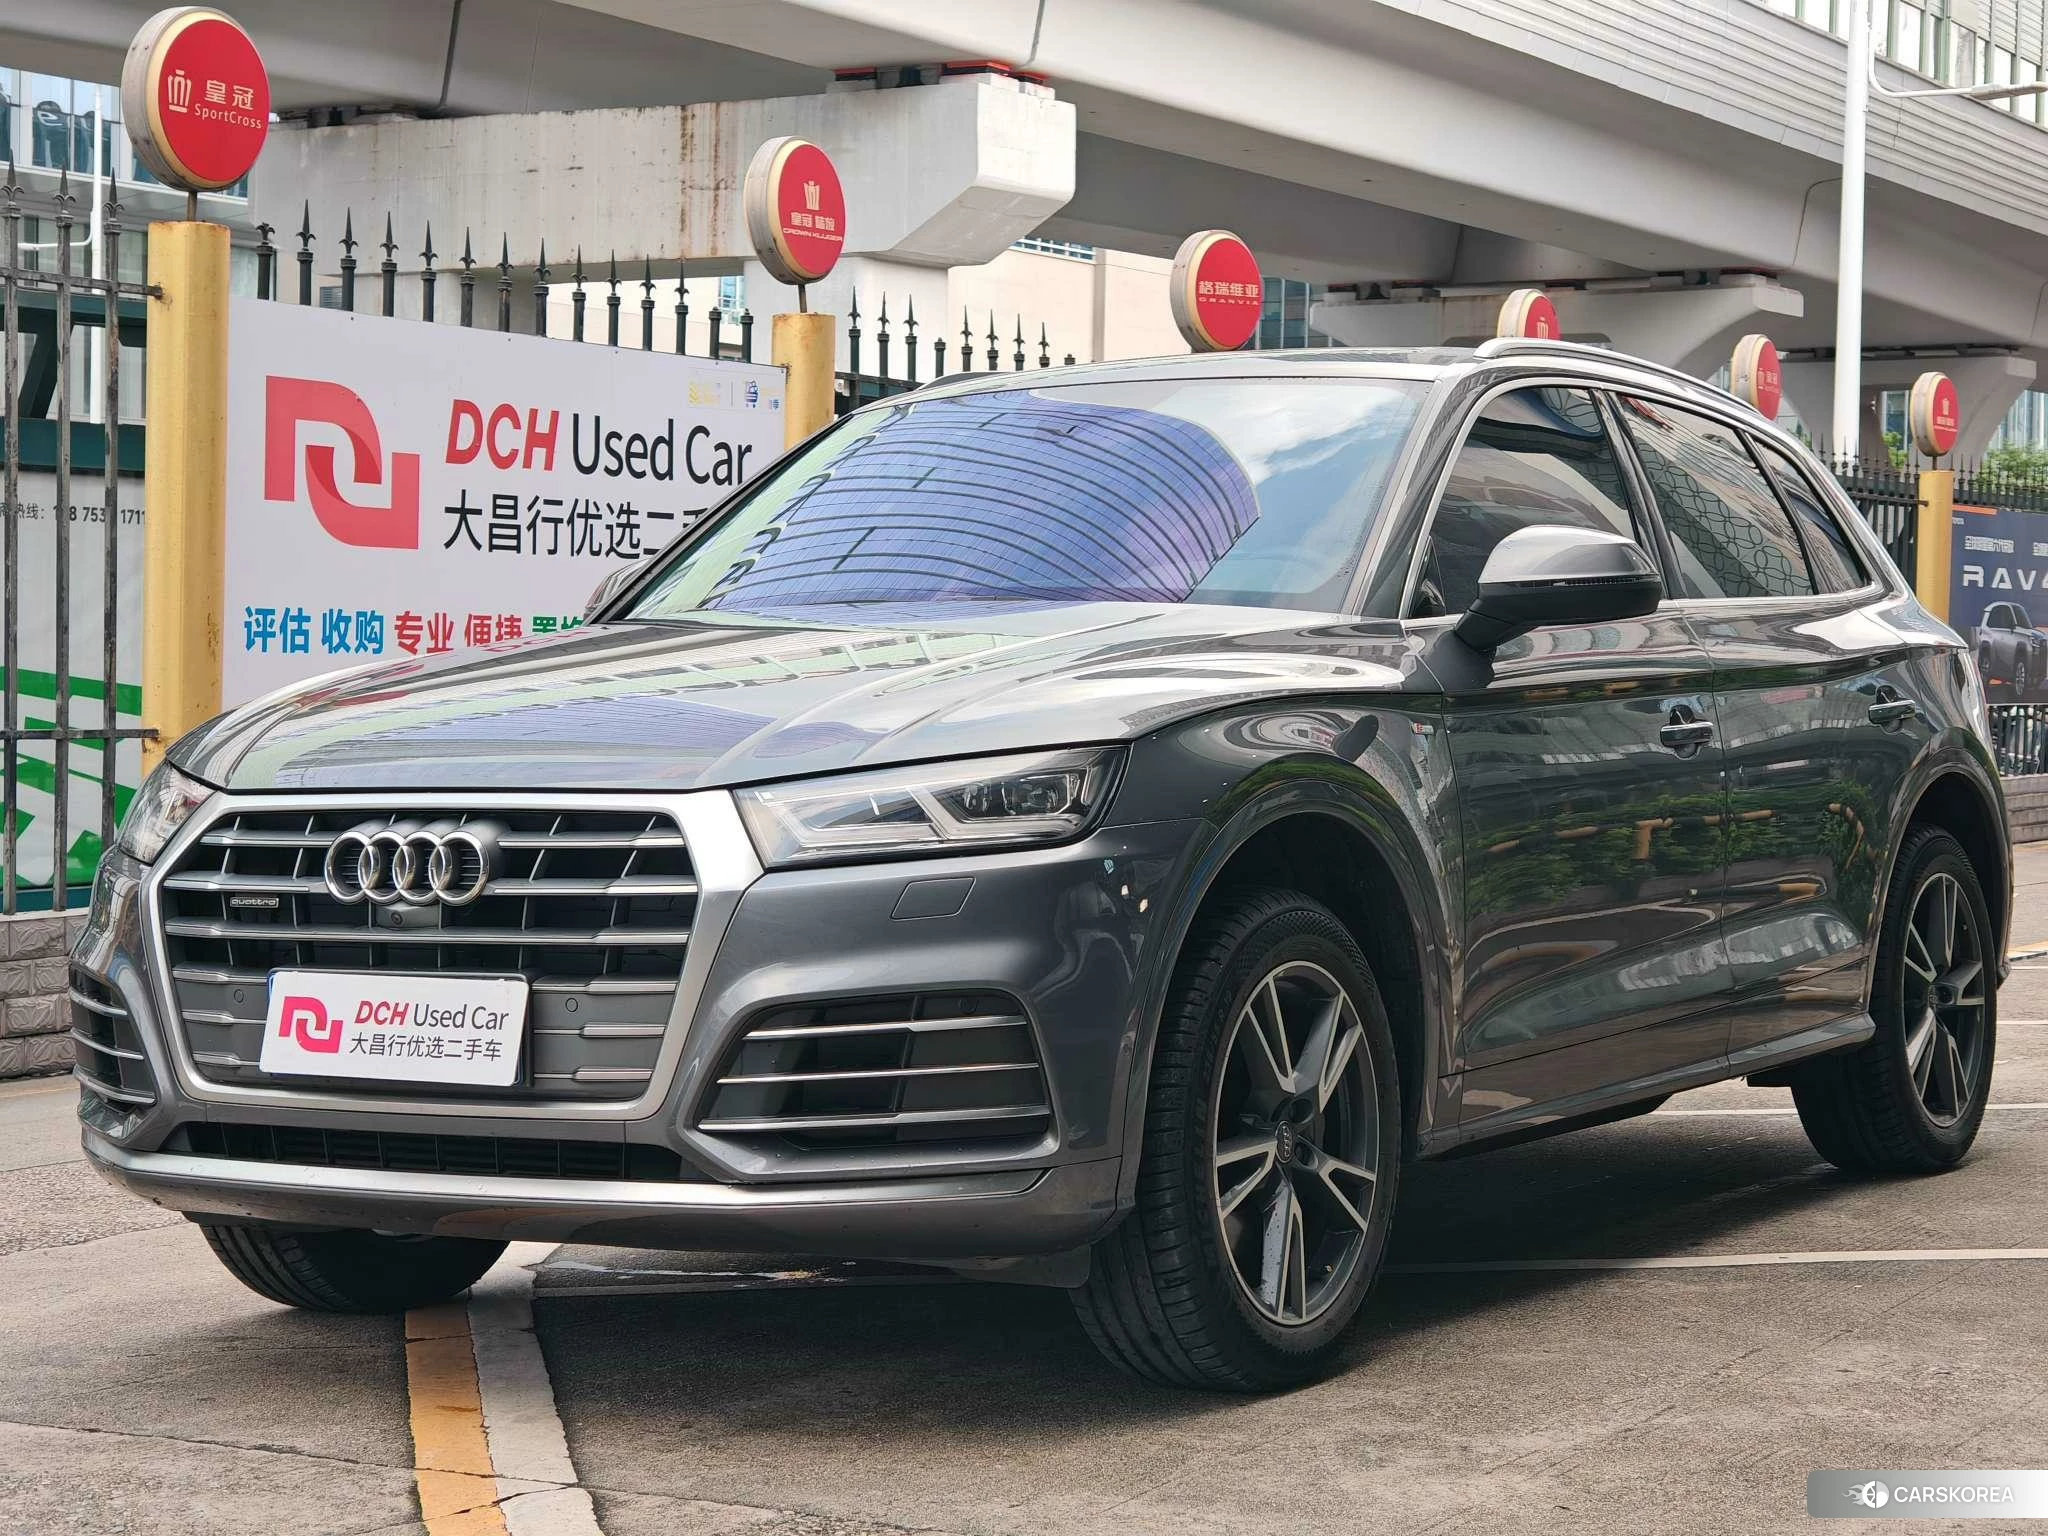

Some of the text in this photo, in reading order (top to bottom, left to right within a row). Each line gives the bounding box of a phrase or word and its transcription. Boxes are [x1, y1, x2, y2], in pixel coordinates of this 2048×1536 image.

[205, 80, 254, 110] 皇冠
[194, 103, 262, 129] SportCross
[1199, 281, 1260, 298] 格瑞维亚
[445, 399, 752, 486] DCH Used Car
[244, 605, 312, 654] 评估
[321, 608, 385, 655] 收购
[394, 611, 454, 655] 专业
[231, 897, 277, 906] quattro
[354, 1000, 509, 1030] DCH Used Car
[349, 1031, 503, 1062] 大昌行优选二手车
